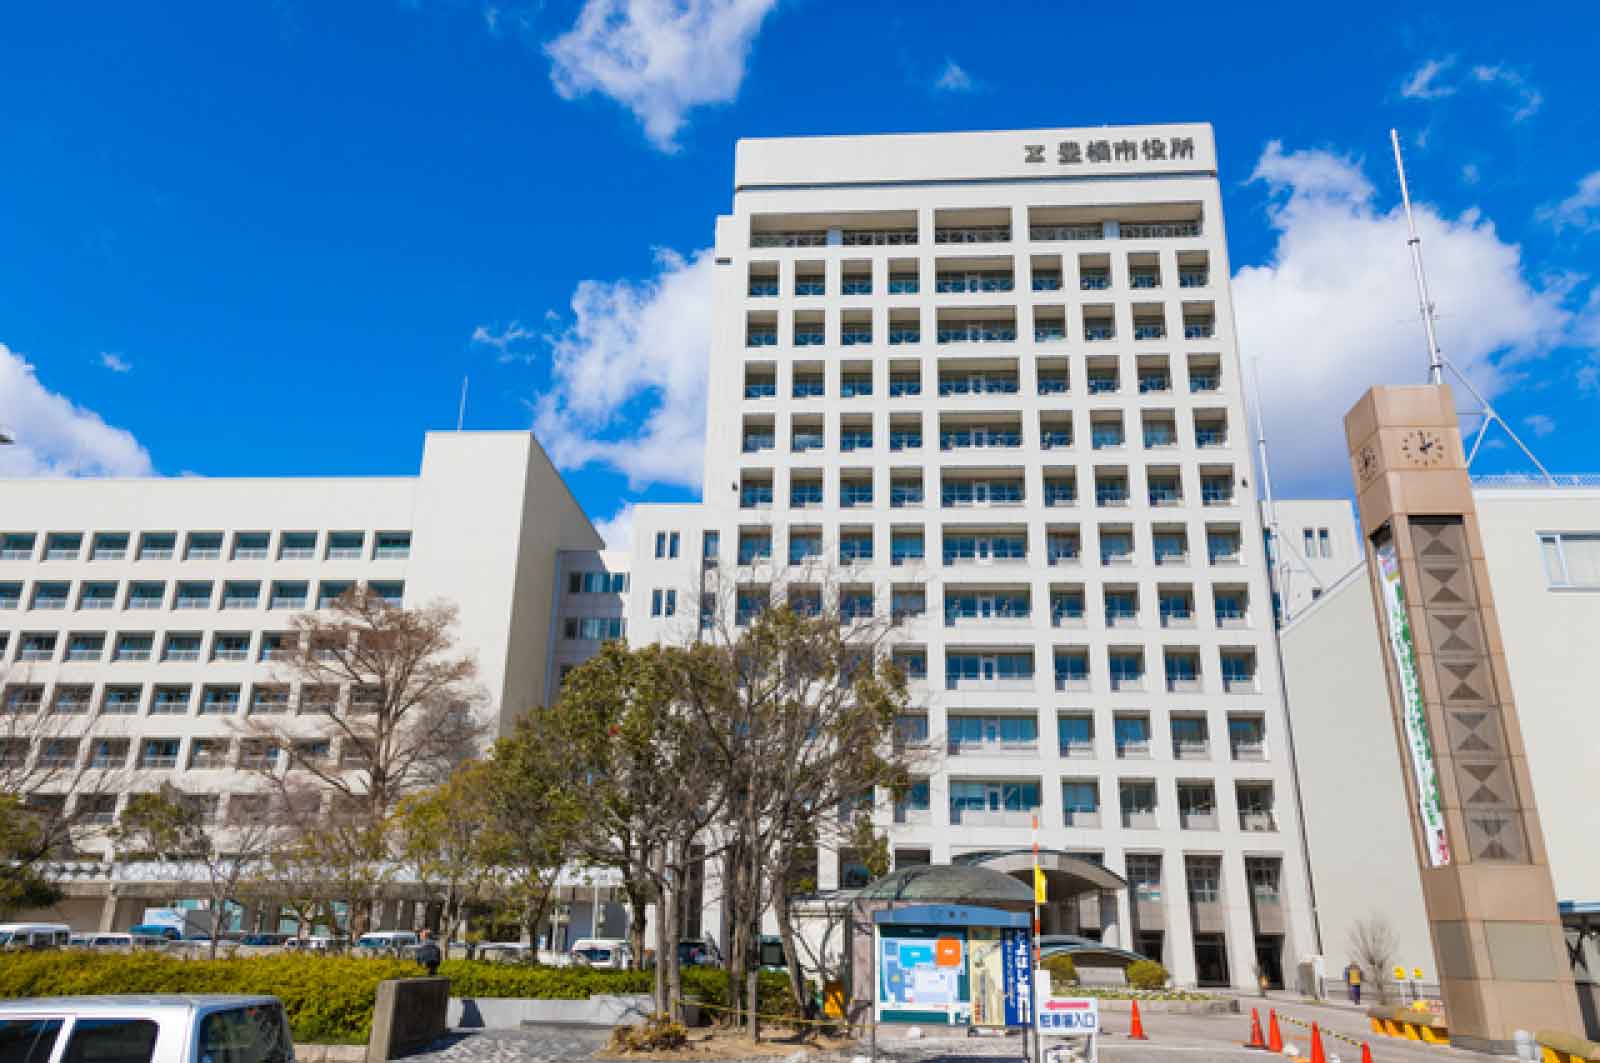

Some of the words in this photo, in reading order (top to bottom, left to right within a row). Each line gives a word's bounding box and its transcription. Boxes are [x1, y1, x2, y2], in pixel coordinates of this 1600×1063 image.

[1057, 137, 1194, 164] 豊橋市役所
